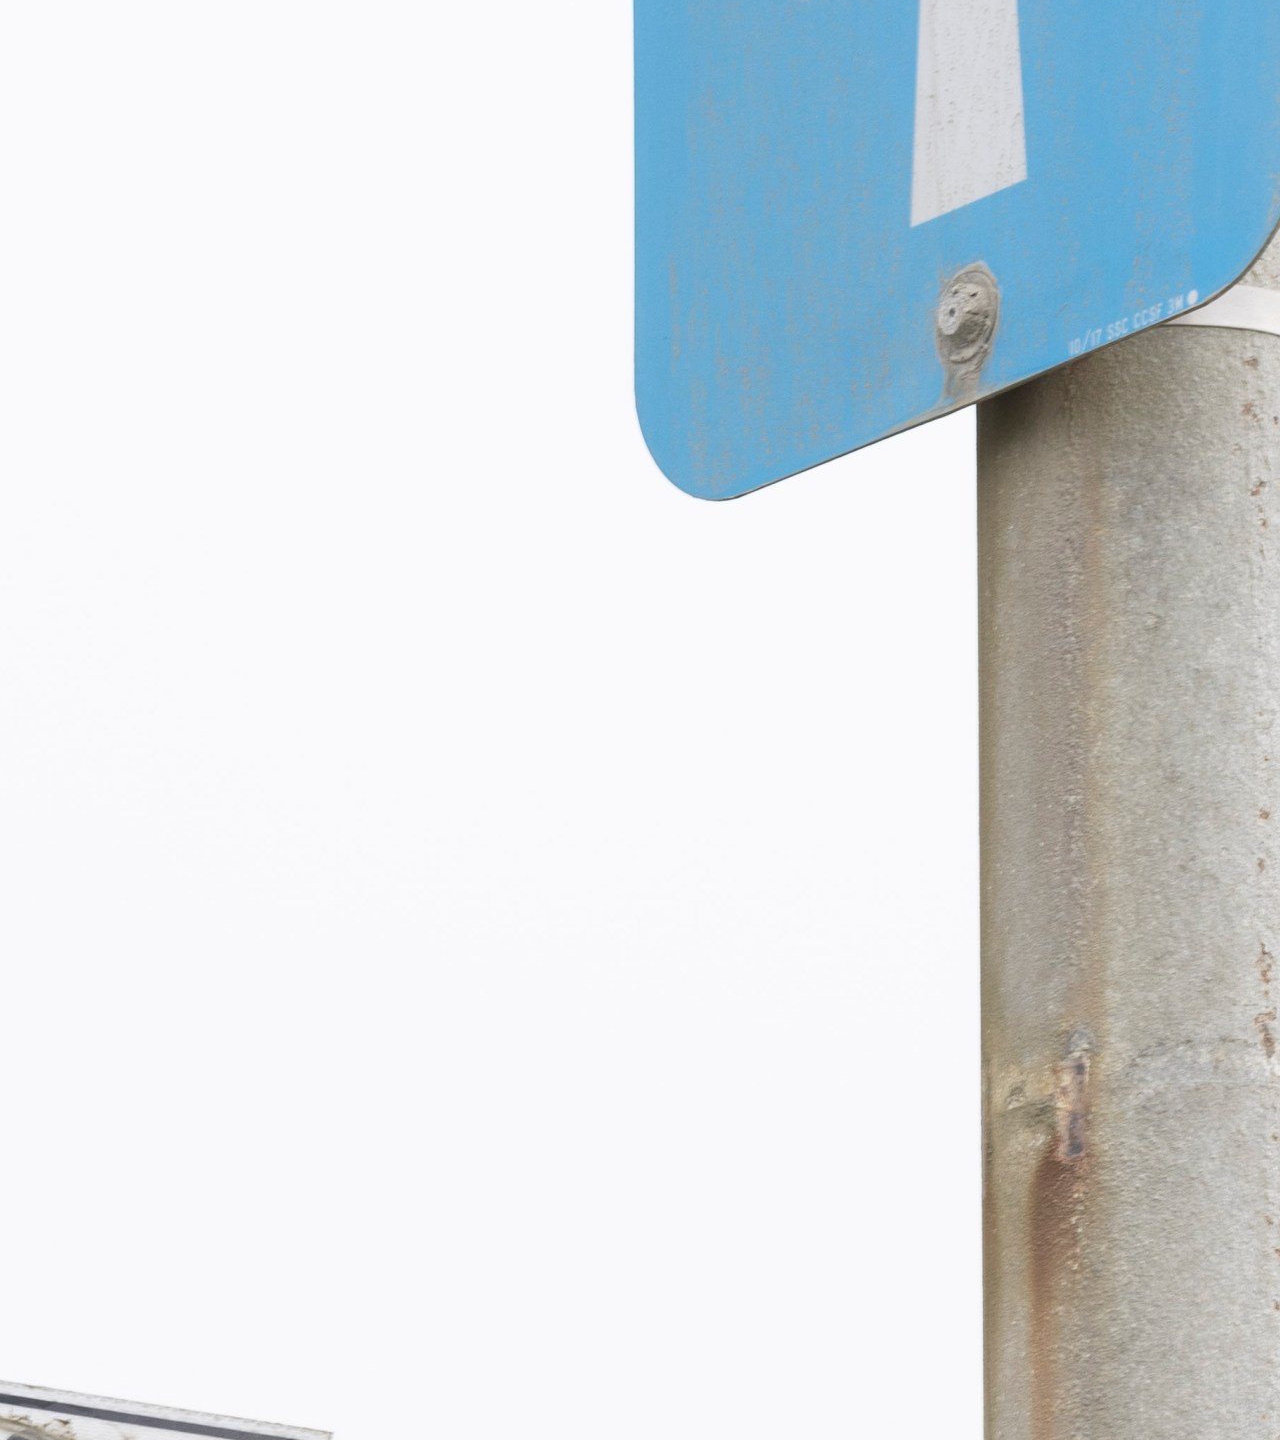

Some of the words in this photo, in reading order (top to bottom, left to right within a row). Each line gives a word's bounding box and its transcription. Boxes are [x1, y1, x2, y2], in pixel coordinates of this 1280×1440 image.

[1070, 328, 1103, 355] 10/17
[1107, 317, 1129, 340] SSC
[1133, 302, 1164, 329] CCSF
[1167, 294, 1185, 315] 3M
